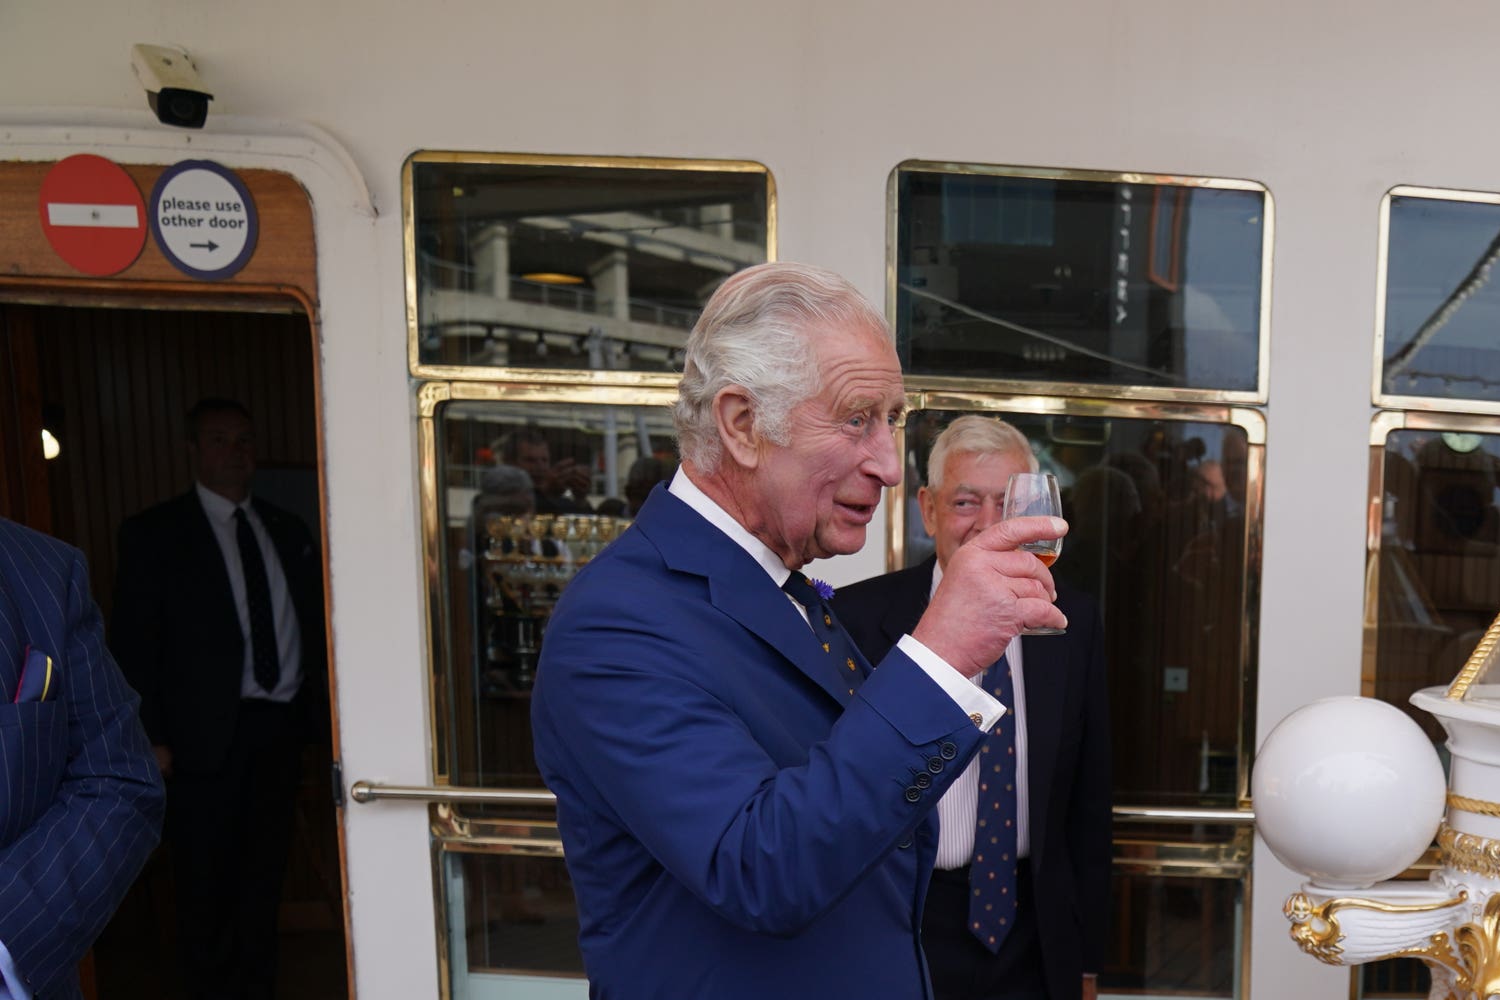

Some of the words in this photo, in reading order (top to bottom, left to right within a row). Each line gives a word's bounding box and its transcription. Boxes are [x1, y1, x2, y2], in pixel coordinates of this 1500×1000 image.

[162, 196, 211, 213] please
[215, 201, 242, 213] use
[161, 214, 204, 228] other
[209, 215, 245, 229] door
